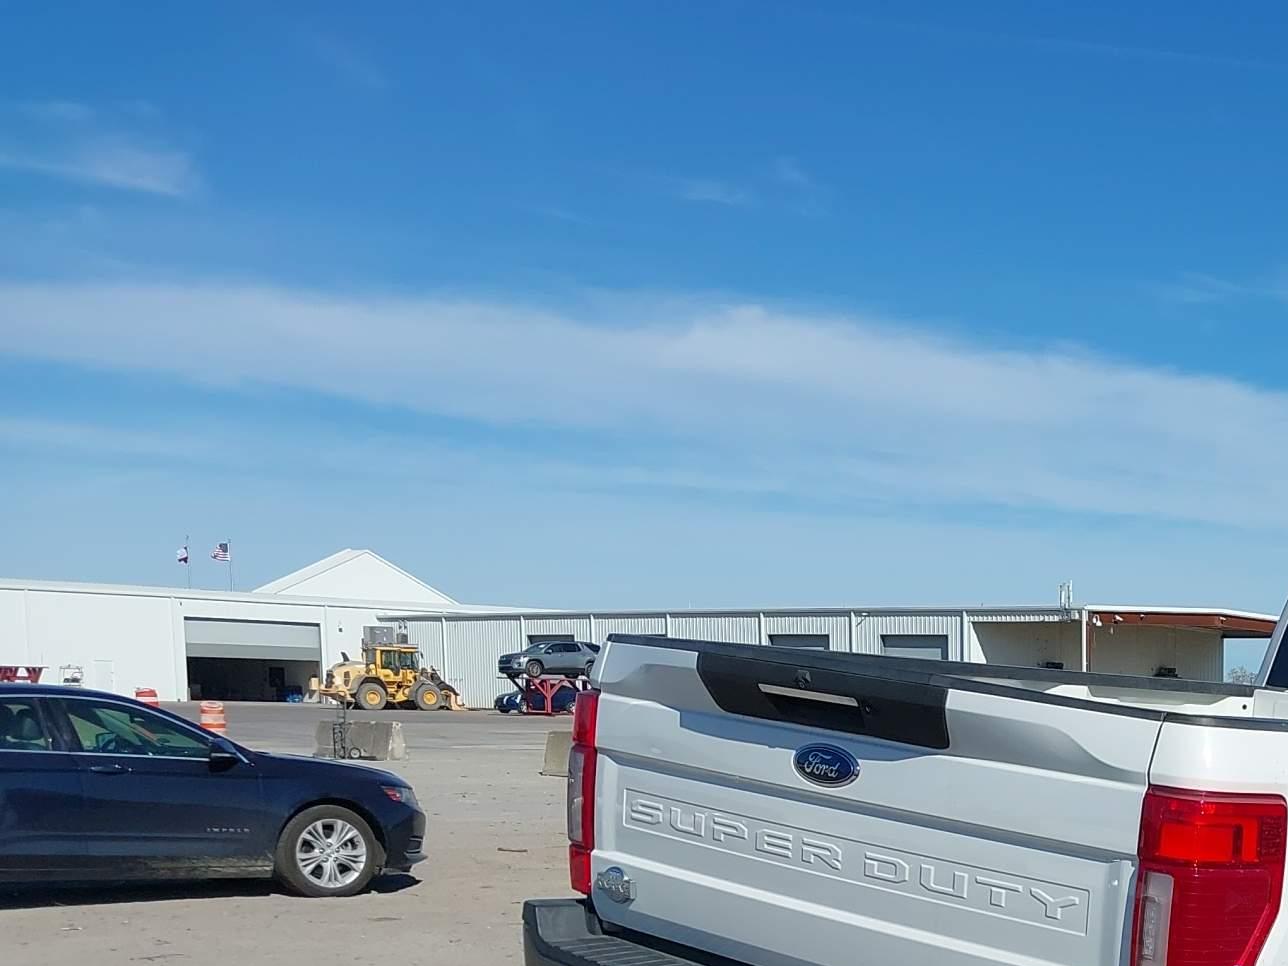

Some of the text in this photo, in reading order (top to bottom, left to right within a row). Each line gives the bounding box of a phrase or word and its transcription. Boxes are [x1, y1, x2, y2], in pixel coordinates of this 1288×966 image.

[804, 751, 840, 778] Ford
[630, 799, 1079, 921] SUPER DUTY
